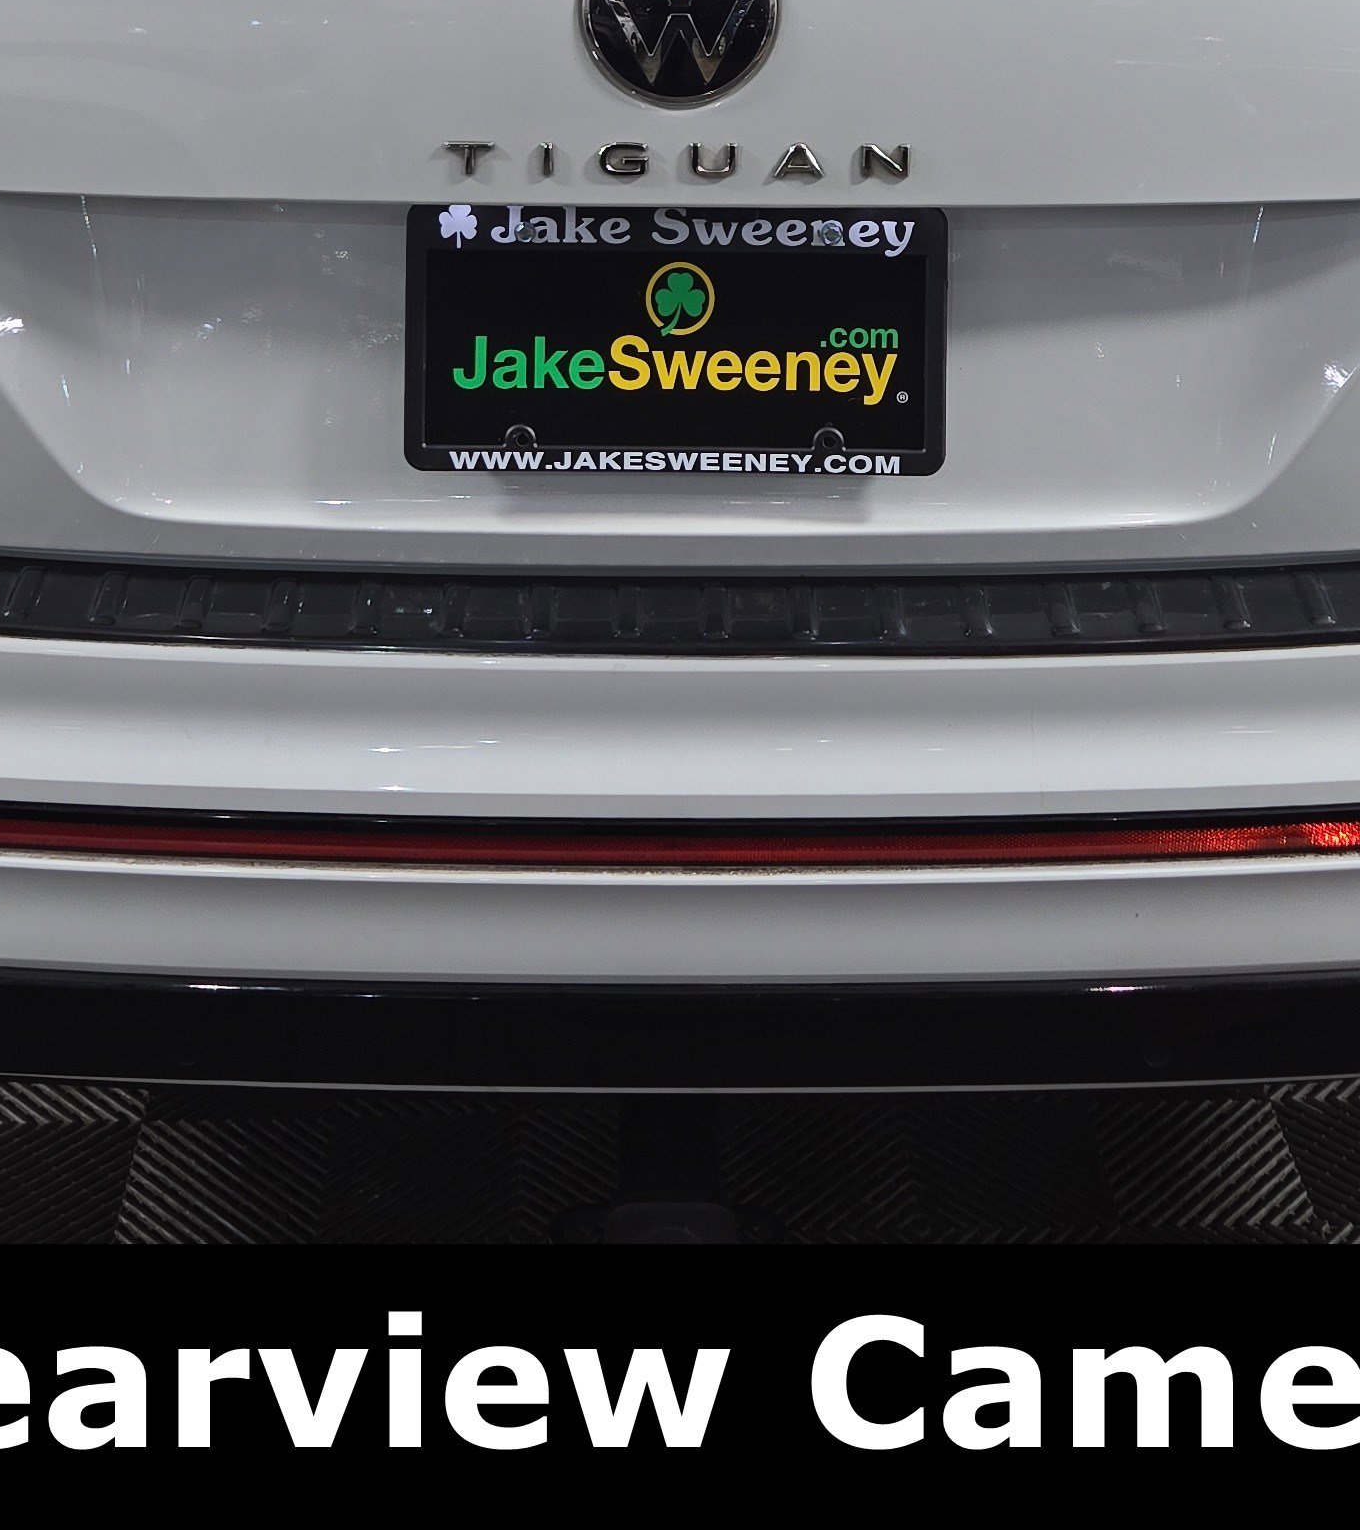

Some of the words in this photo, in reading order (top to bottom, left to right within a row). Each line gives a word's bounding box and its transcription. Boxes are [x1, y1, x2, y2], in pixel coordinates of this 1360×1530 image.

[444, 140, 912, 179] TIGUAN
[490, 204, 631, 244] Jake
[449, 450, 901, 475] WWW.JAKESWEENEY.COM
